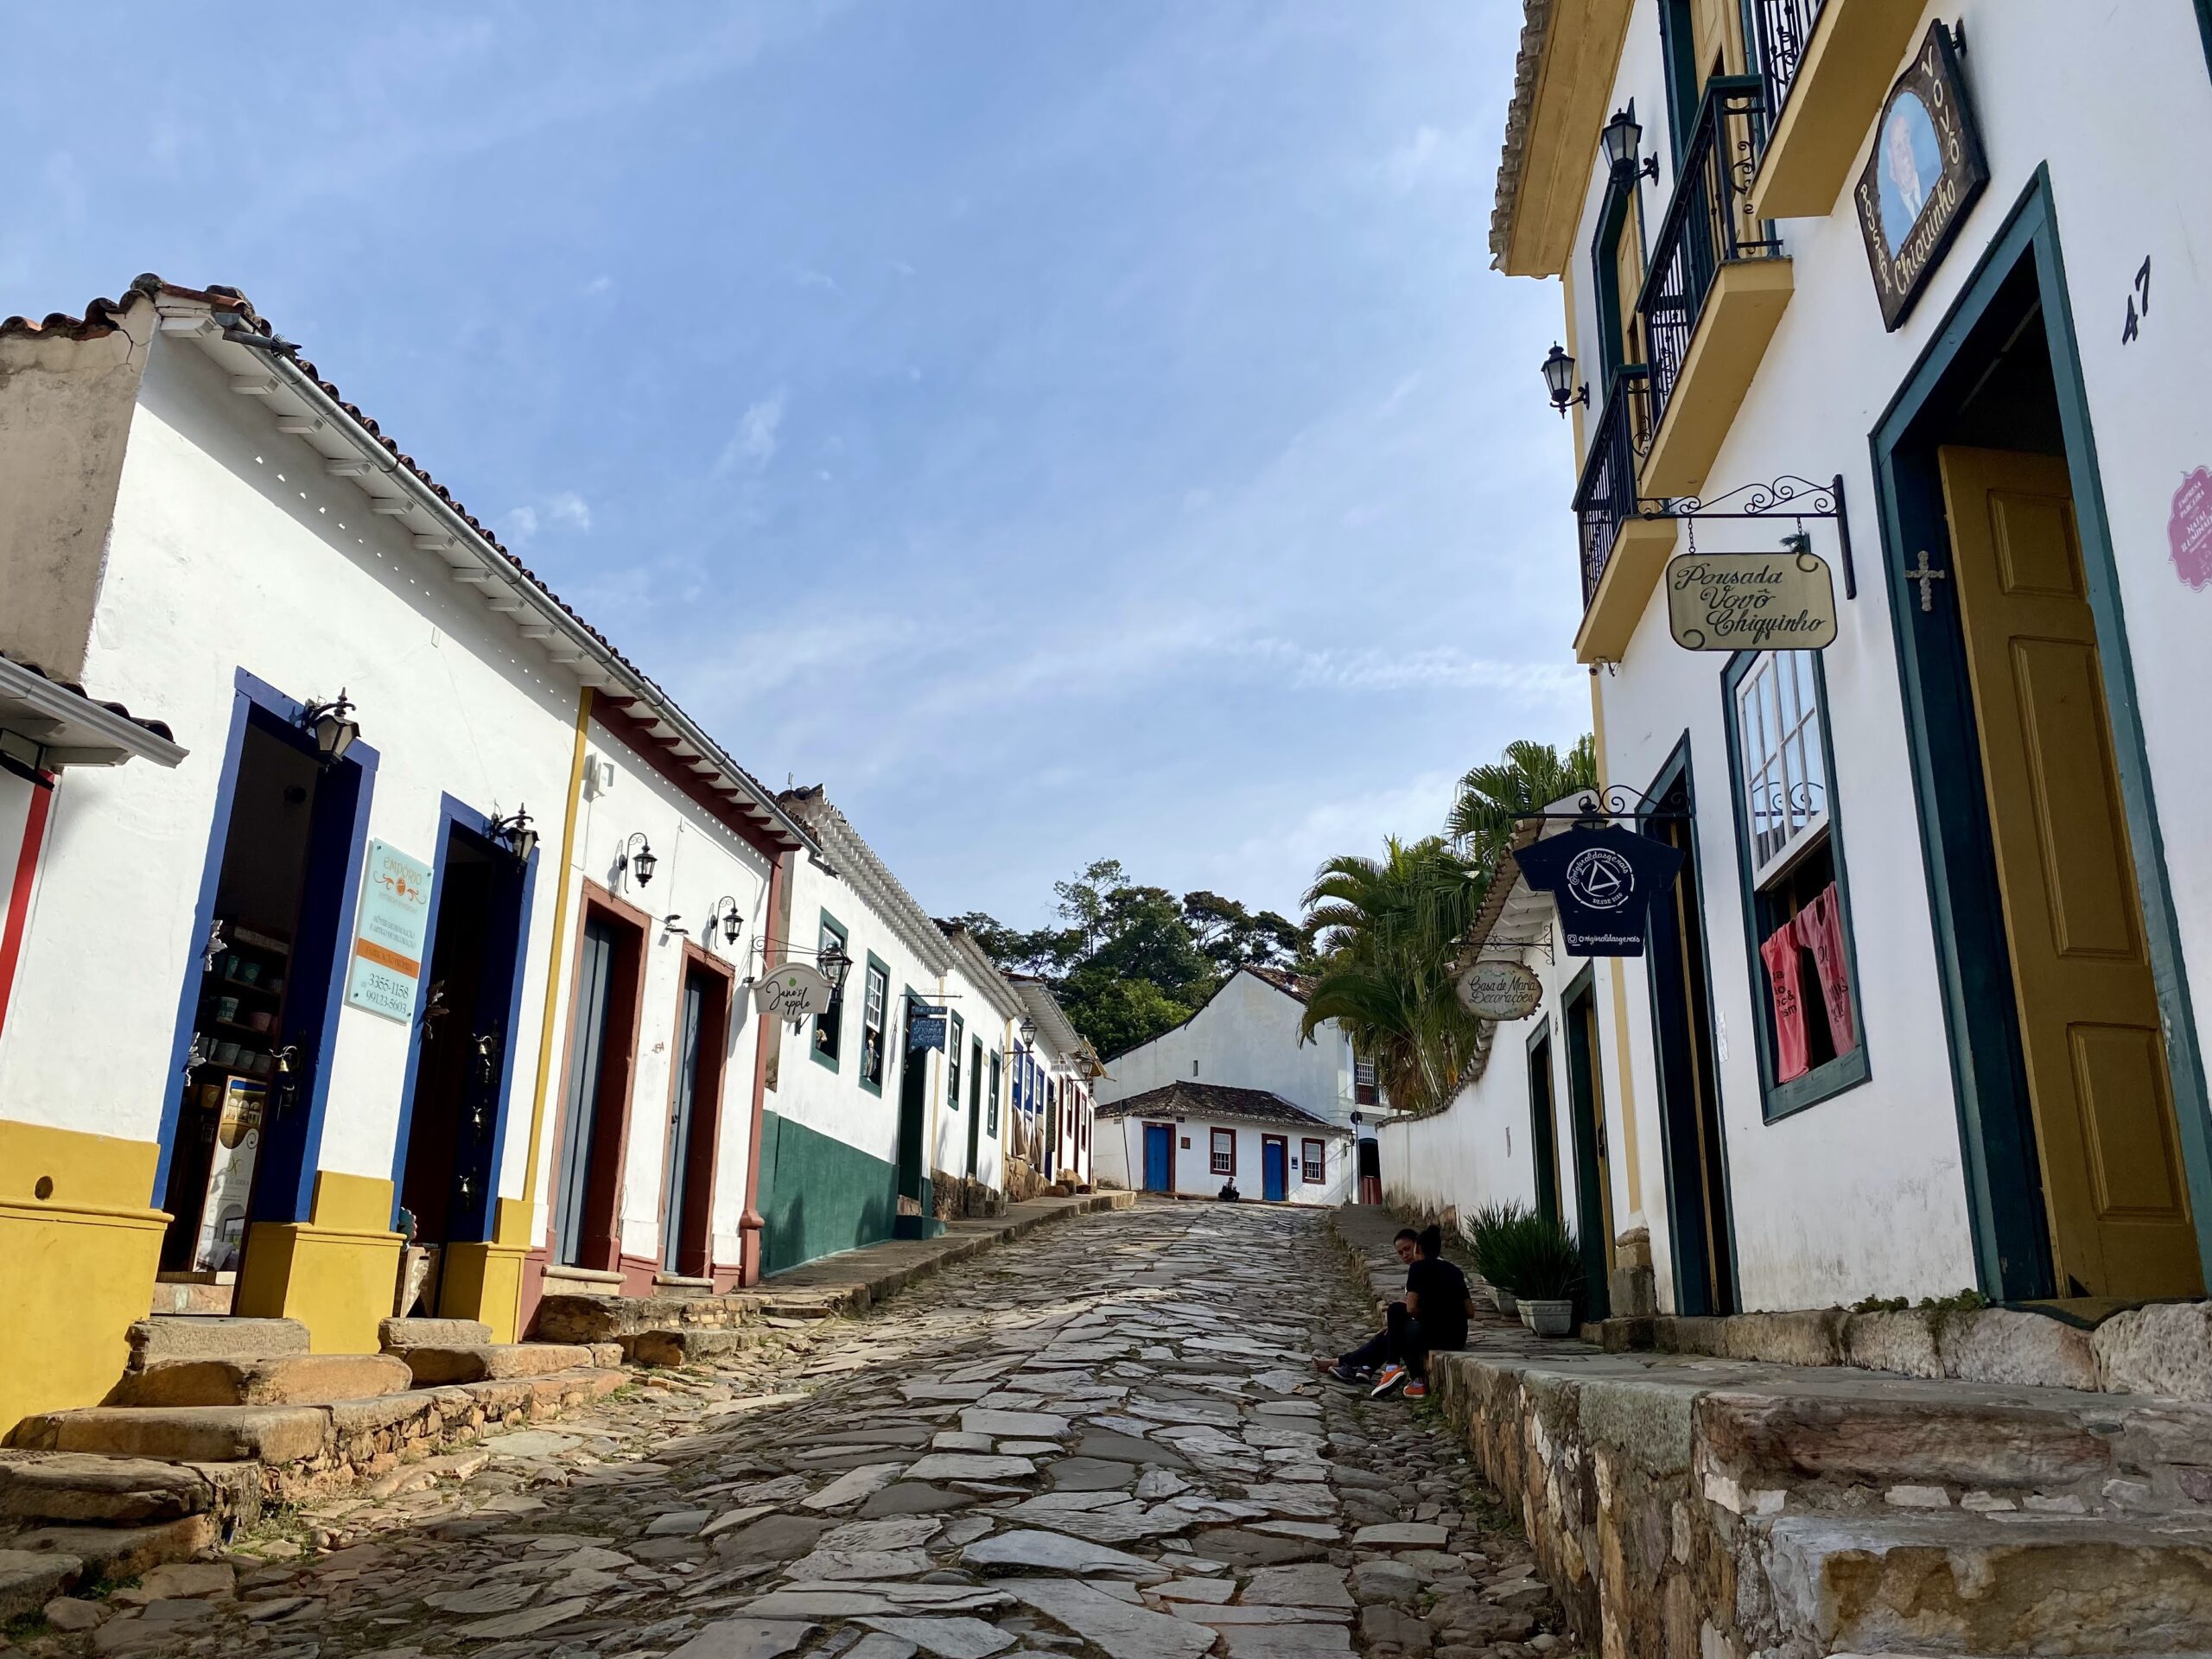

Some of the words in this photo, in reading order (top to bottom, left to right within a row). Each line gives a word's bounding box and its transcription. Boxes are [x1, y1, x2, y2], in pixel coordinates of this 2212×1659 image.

[1922, 45, 1960, 164] VOVÔ
[1860, 183, 1892, 294] POUSADA
[1894, 178, 1956, 296] Chiquinho
[2121, 254, 2151, 346] 47
[1675, 563, 1783, 591] Pousada
[1700, 585, 1777, 610] Vovô
[1706, 608, 1827, 645] Chiquinho
[368, 973, 410, 1000] 3355-1158
[766, 981, 803, 1011] Jane's
[1467, 975, 1496, 992] Casa
[1496, 978, 1507, 991] de
[1505, 975, 1536, 995] Maria
[1468, 990, 1535, 1006] Decorações
[365, 990, 408, 1014] 99123-5603
[785, 987, 810, 1016] apple
